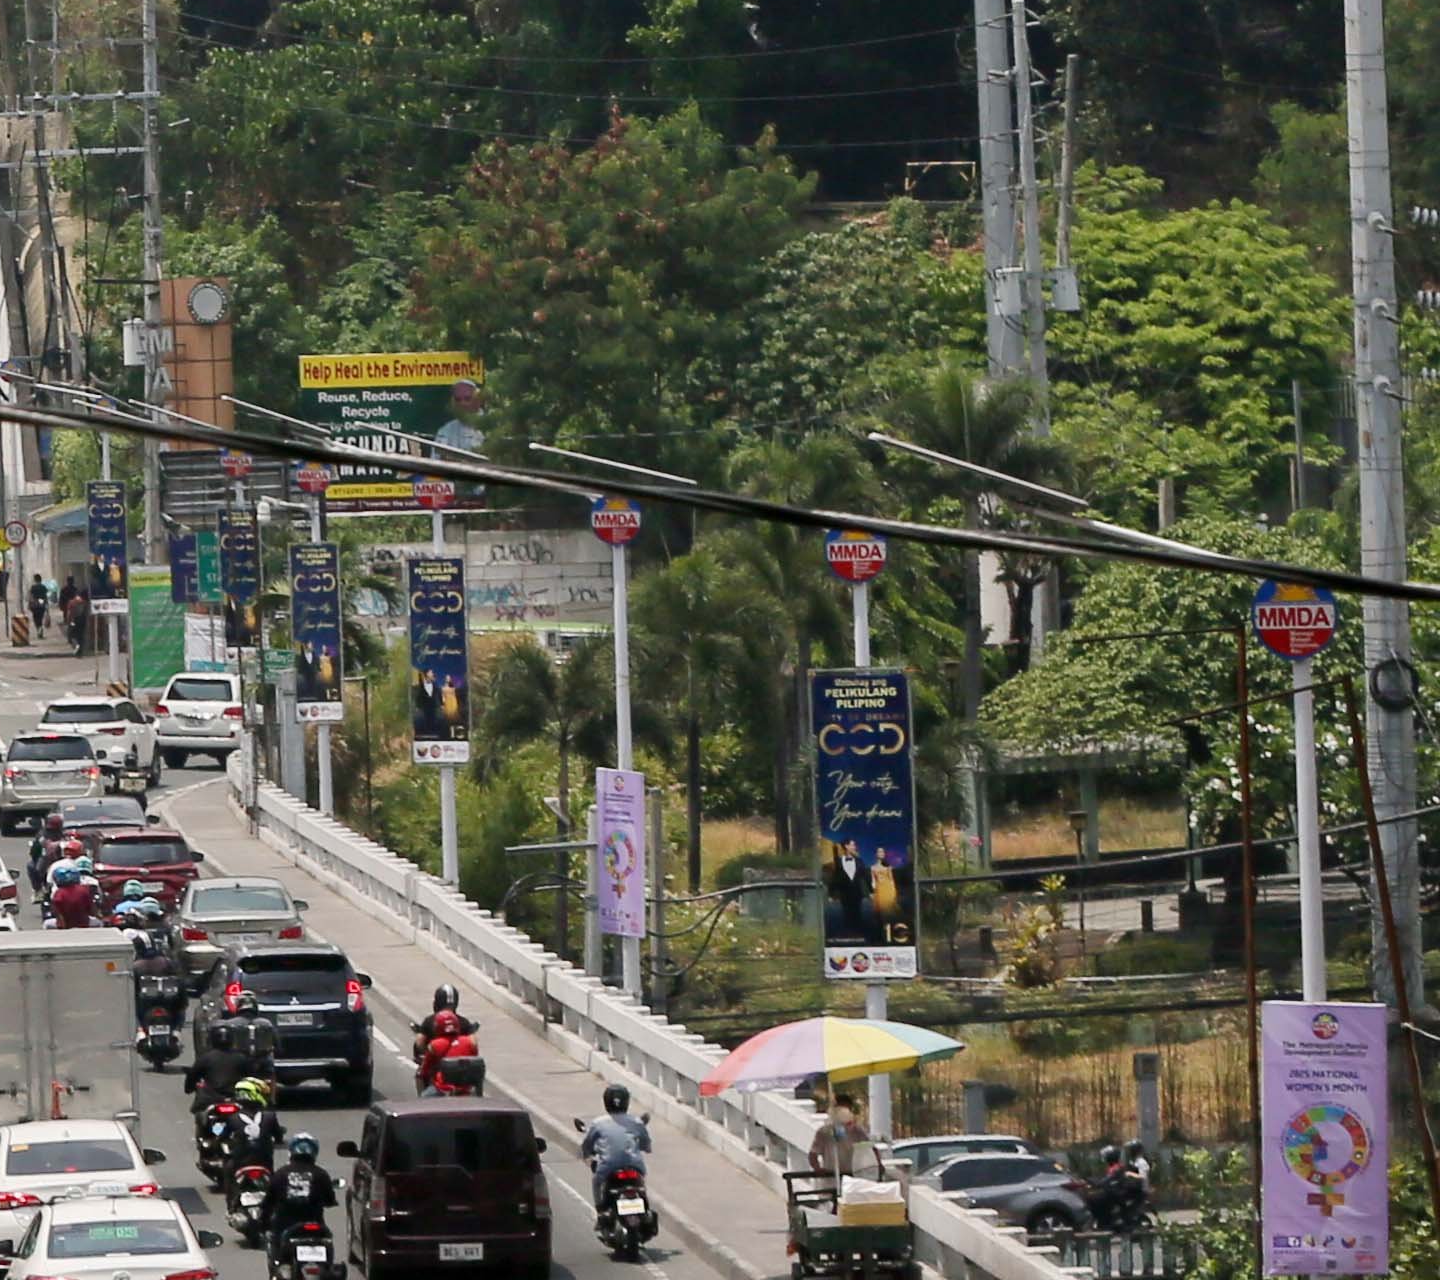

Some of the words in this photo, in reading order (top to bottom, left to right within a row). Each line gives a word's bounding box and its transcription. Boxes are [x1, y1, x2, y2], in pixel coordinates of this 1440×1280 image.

[303, 362, 331, 383] Help
[335, 361, 364, 380] Heal
[366, 361, 390, 378] the
[393, 357, 482, 379] Environment!
[318, 391, 360, 404] Reuse,
[362, 390, 413, 403] Reduce,
[341, 406, 391, 419] Recycle
[414, 481, 453, 495] MMDA
[593, 513, 638, 526] MMDA
[829, 544, 882, 559] MMDA
[1258, 606, 1331, 627] MMDA
[824, 687, 897, 698] PELIKULANG
[836, 699, 886, 709] PILIPINO
[1313, 1070, 1361, 1080] NATIONAL
[1332, 1083, 1368, 1093] MONTH
